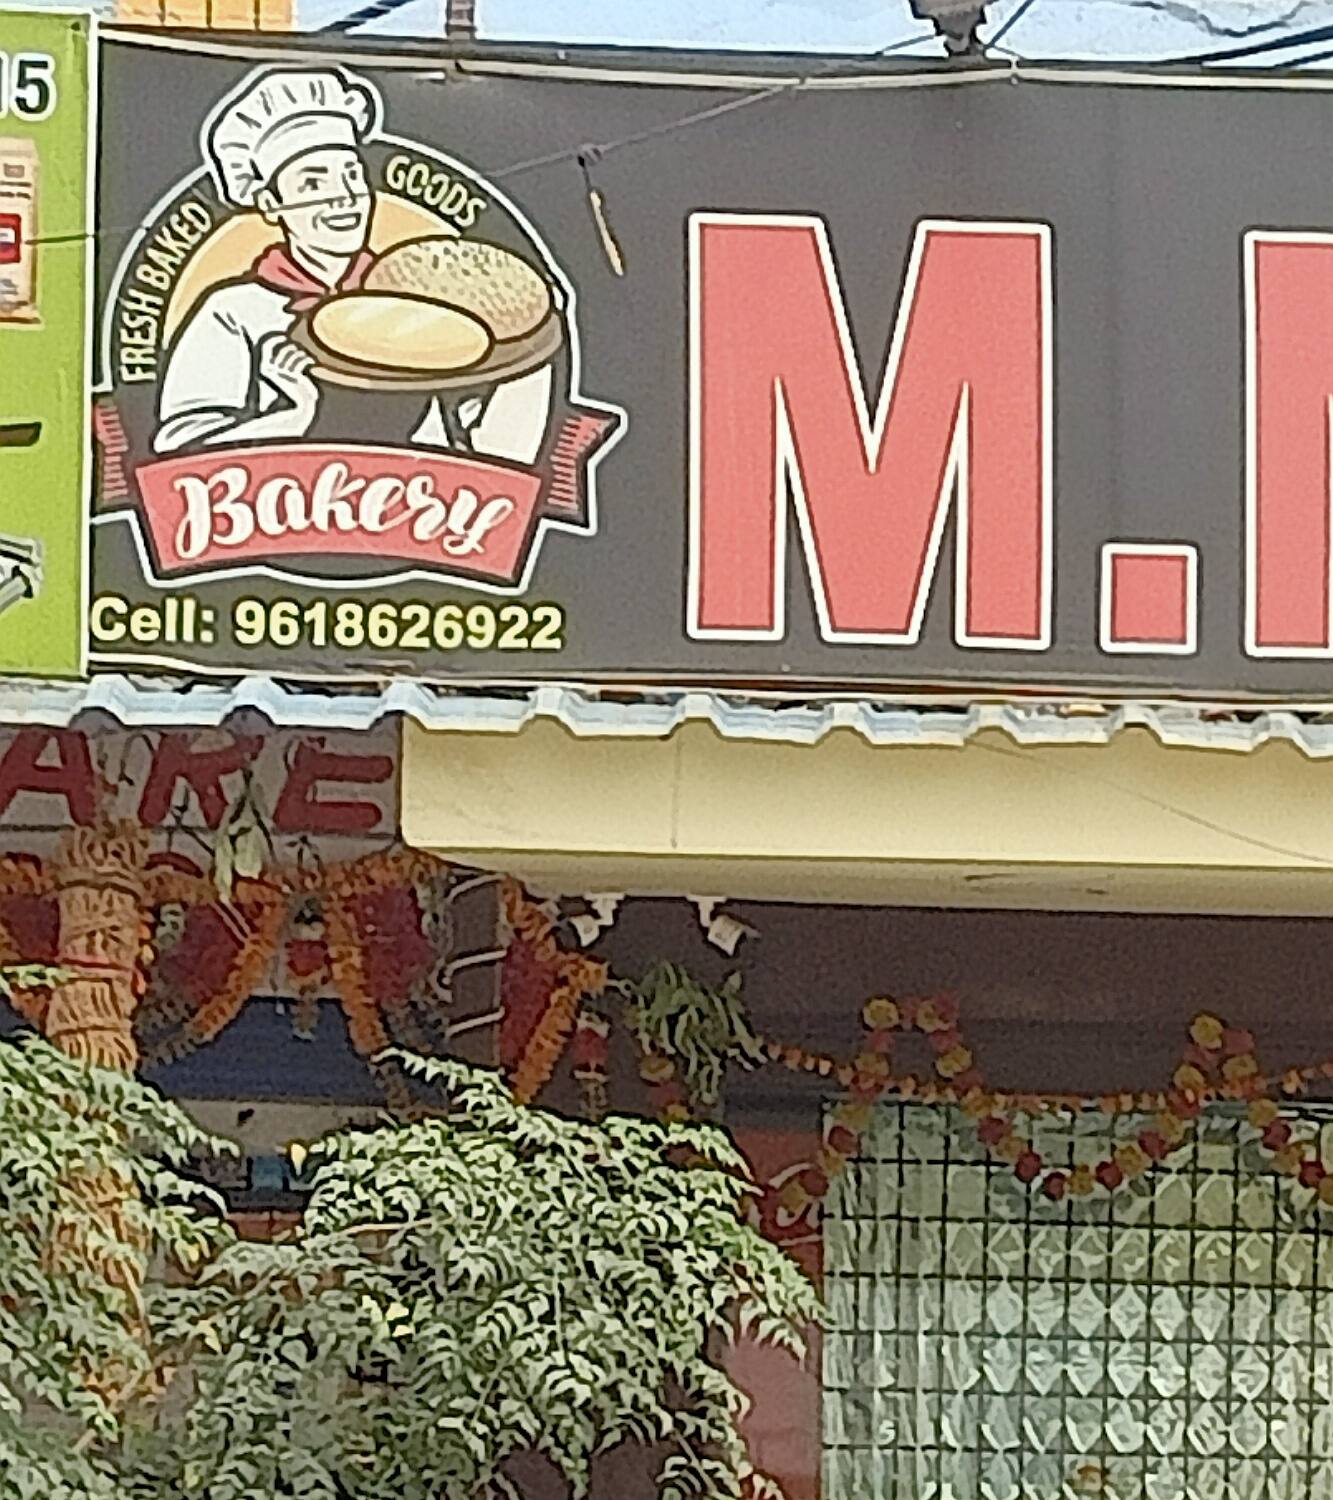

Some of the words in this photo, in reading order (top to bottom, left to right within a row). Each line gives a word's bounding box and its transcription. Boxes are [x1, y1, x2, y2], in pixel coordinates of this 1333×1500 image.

[0, 56, 51, 116] 5
[385, 153, 488, 229] GOODS
[118, 297, 161, 384] FRESH
[141, 199, 213, 293] BAKED
[173, 461, 515, 560] Bakery
[90, 597, 214, 643] Cell:
[234, 600, 563, 650] 9618626922
